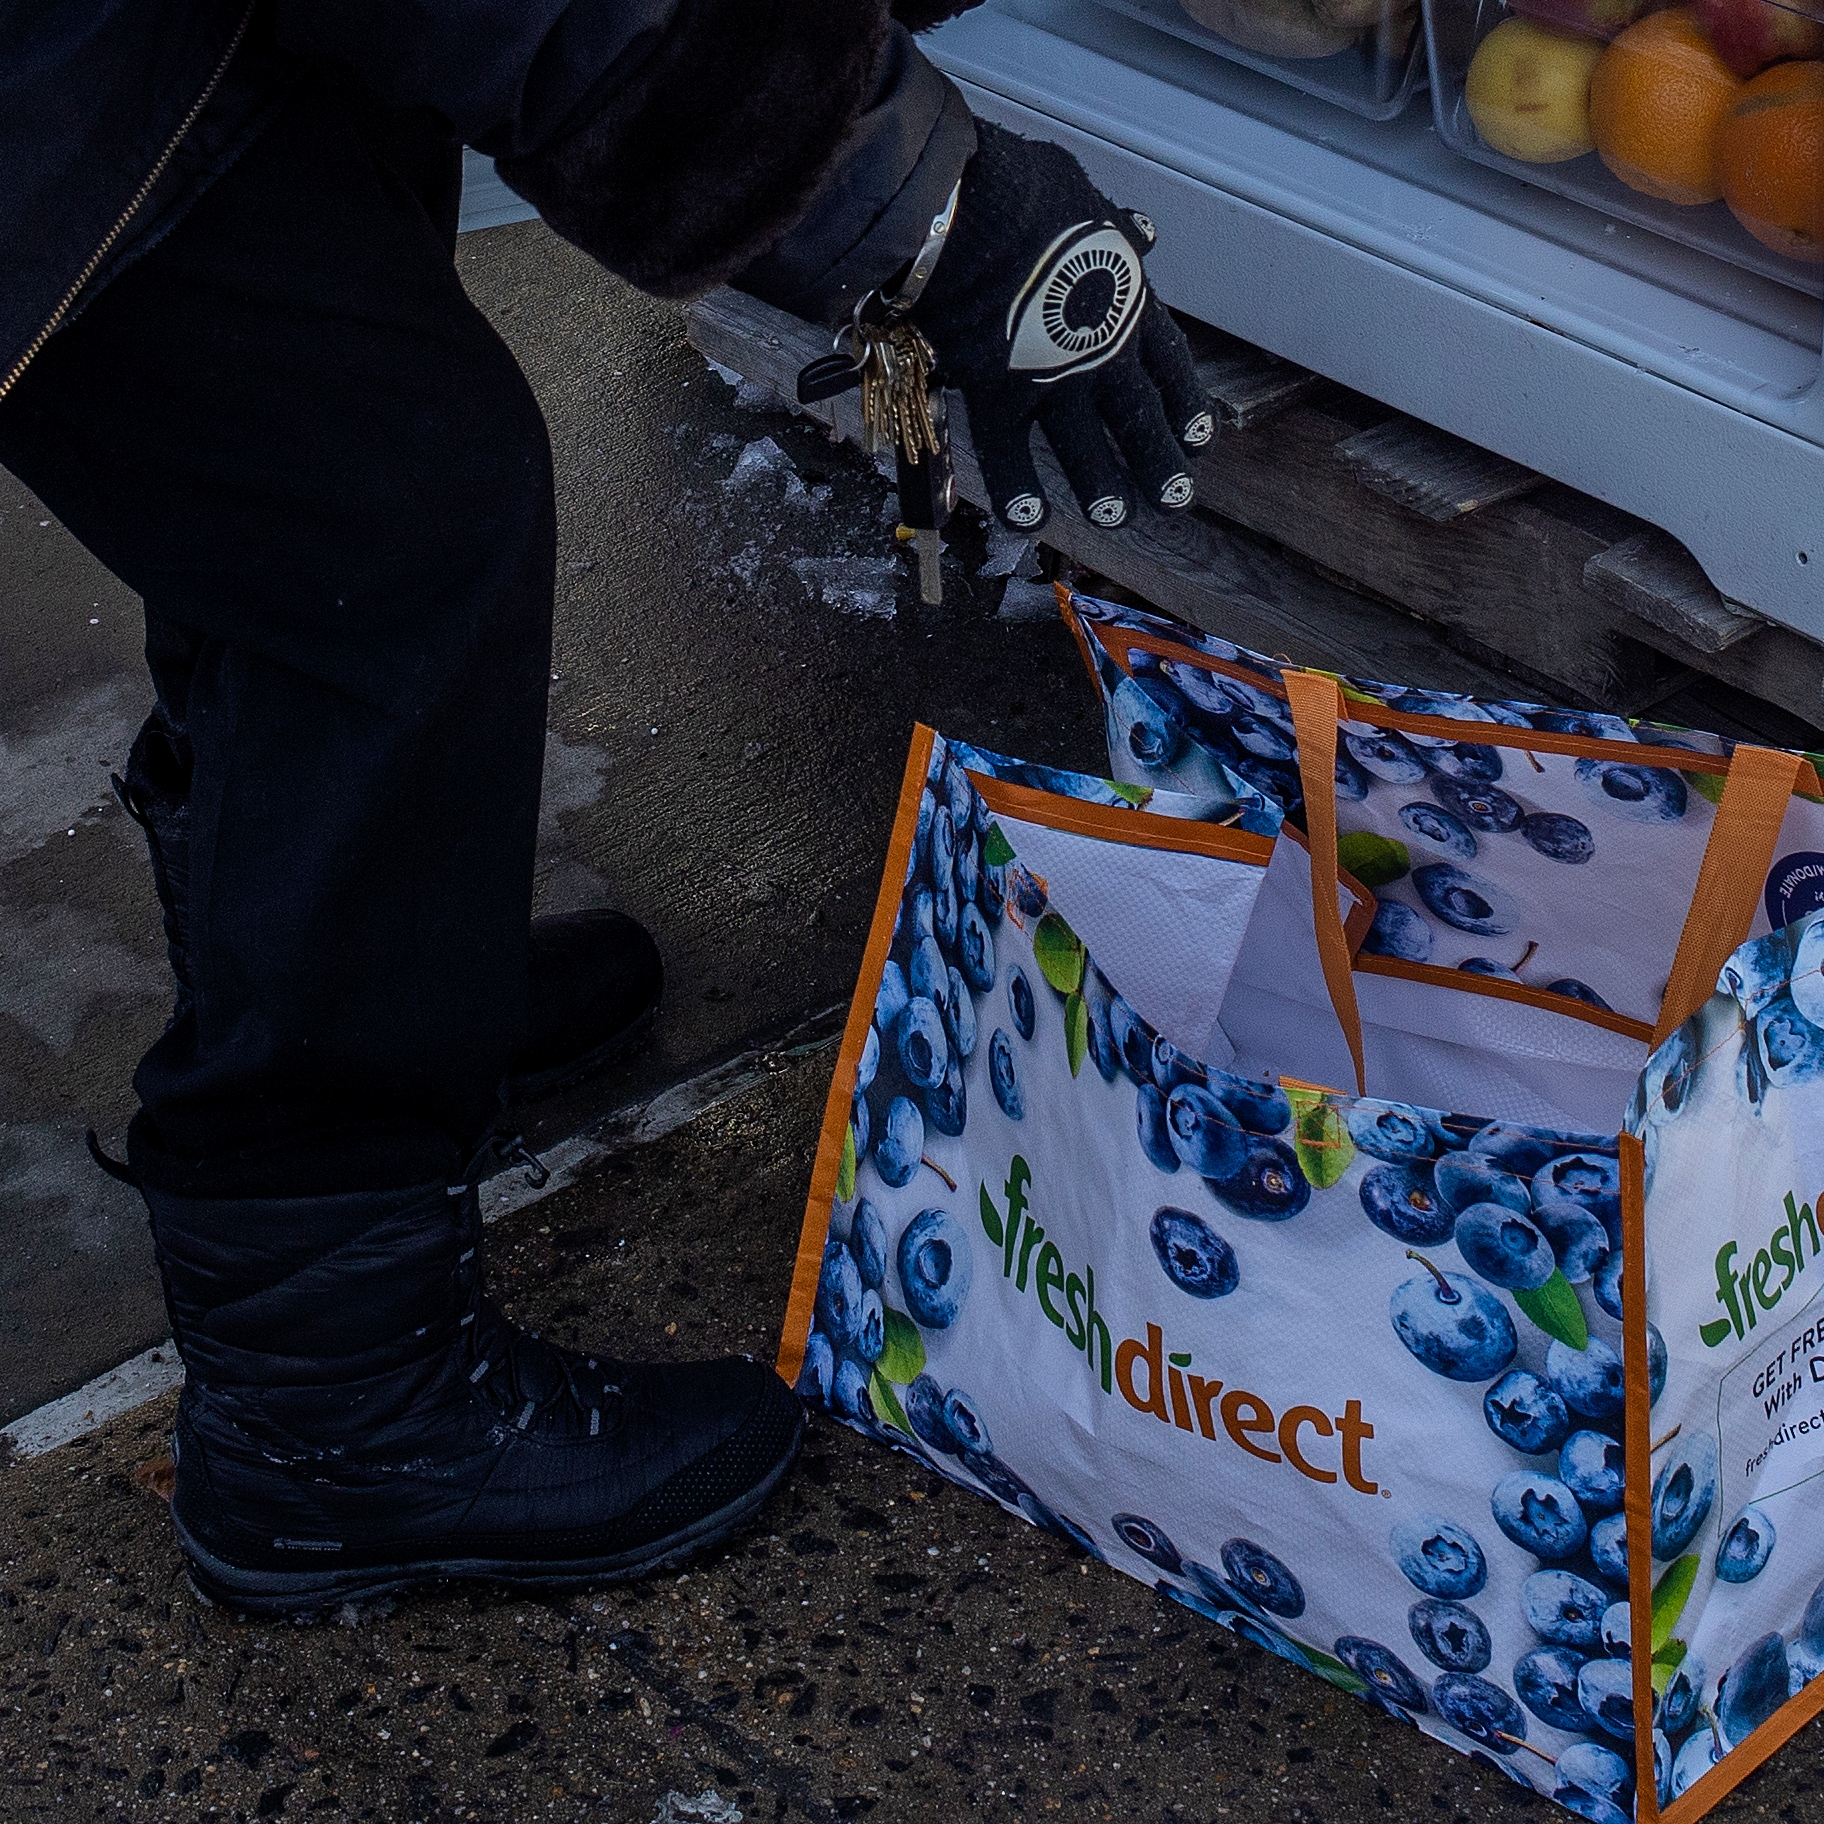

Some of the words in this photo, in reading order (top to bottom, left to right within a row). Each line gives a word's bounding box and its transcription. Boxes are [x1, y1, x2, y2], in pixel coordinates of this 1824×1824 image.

[980, 1154, 1379, 1495] freshdirect
[1752, 1350, 1786, 1399] GET
[1764, 1372, 1803, 1420] With
